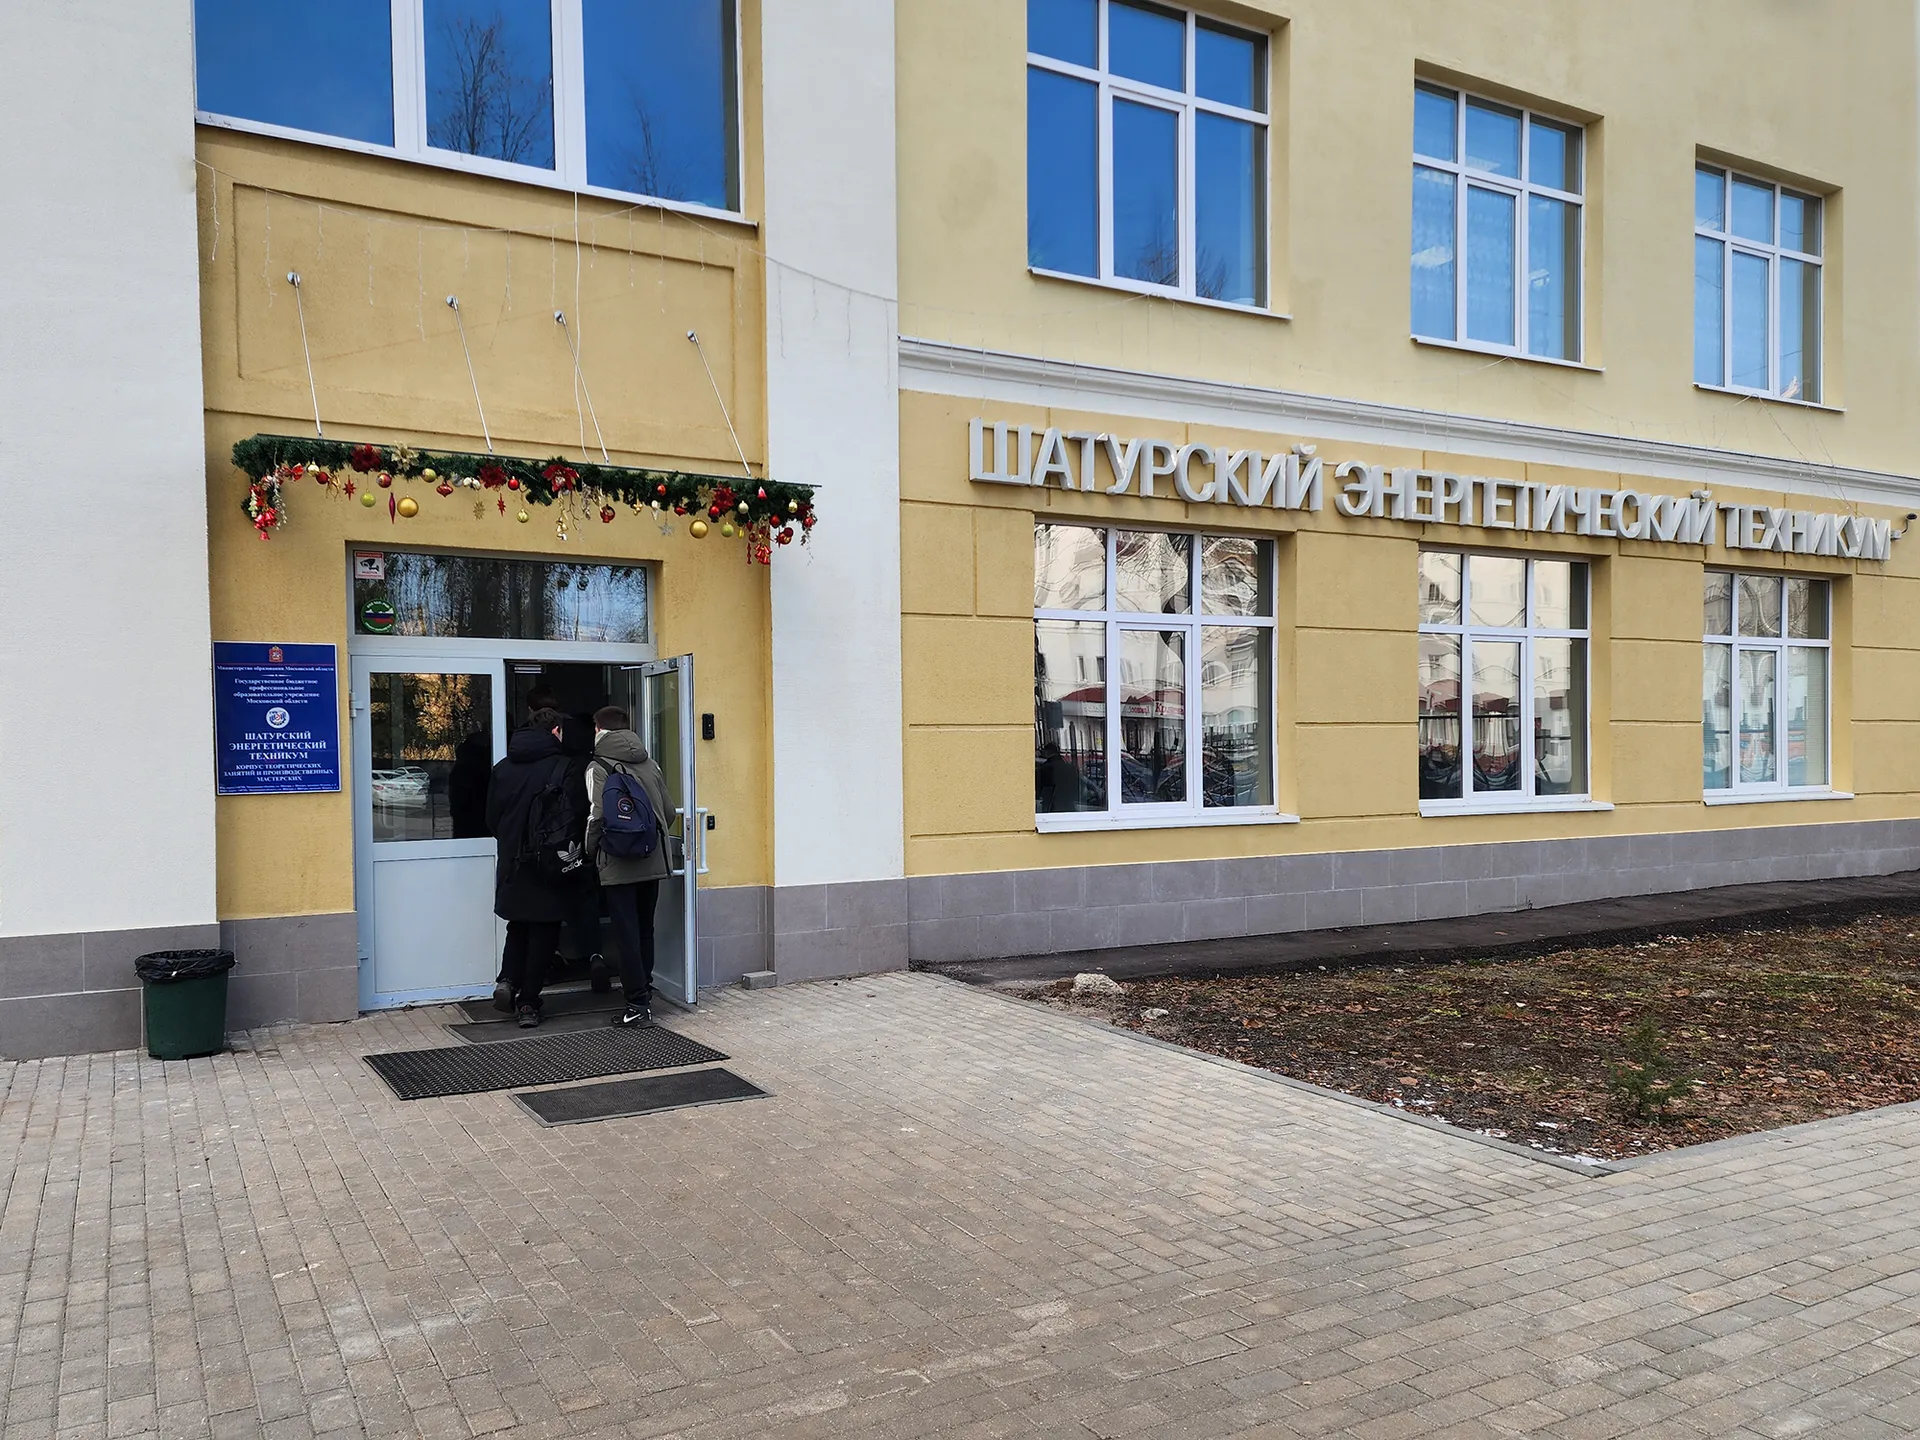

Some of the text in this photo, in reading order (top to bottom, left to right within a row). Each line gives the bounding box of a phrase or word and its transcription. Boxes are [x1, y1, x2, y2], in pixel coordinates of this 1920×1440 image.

[969, 416, 1891, 561] ШАТУРСКИЙ ЭНЕРГЕТИЧЕСКИЙ ТЕХНИКУМ
[244, 730, 311, 740] ШАТУРСКИЙ
[229, 740, 326, 751] ЭНЕРГЕТИЧЕСКИЙ
[249, 752, 308, 760] ТЕХНИКУМ
